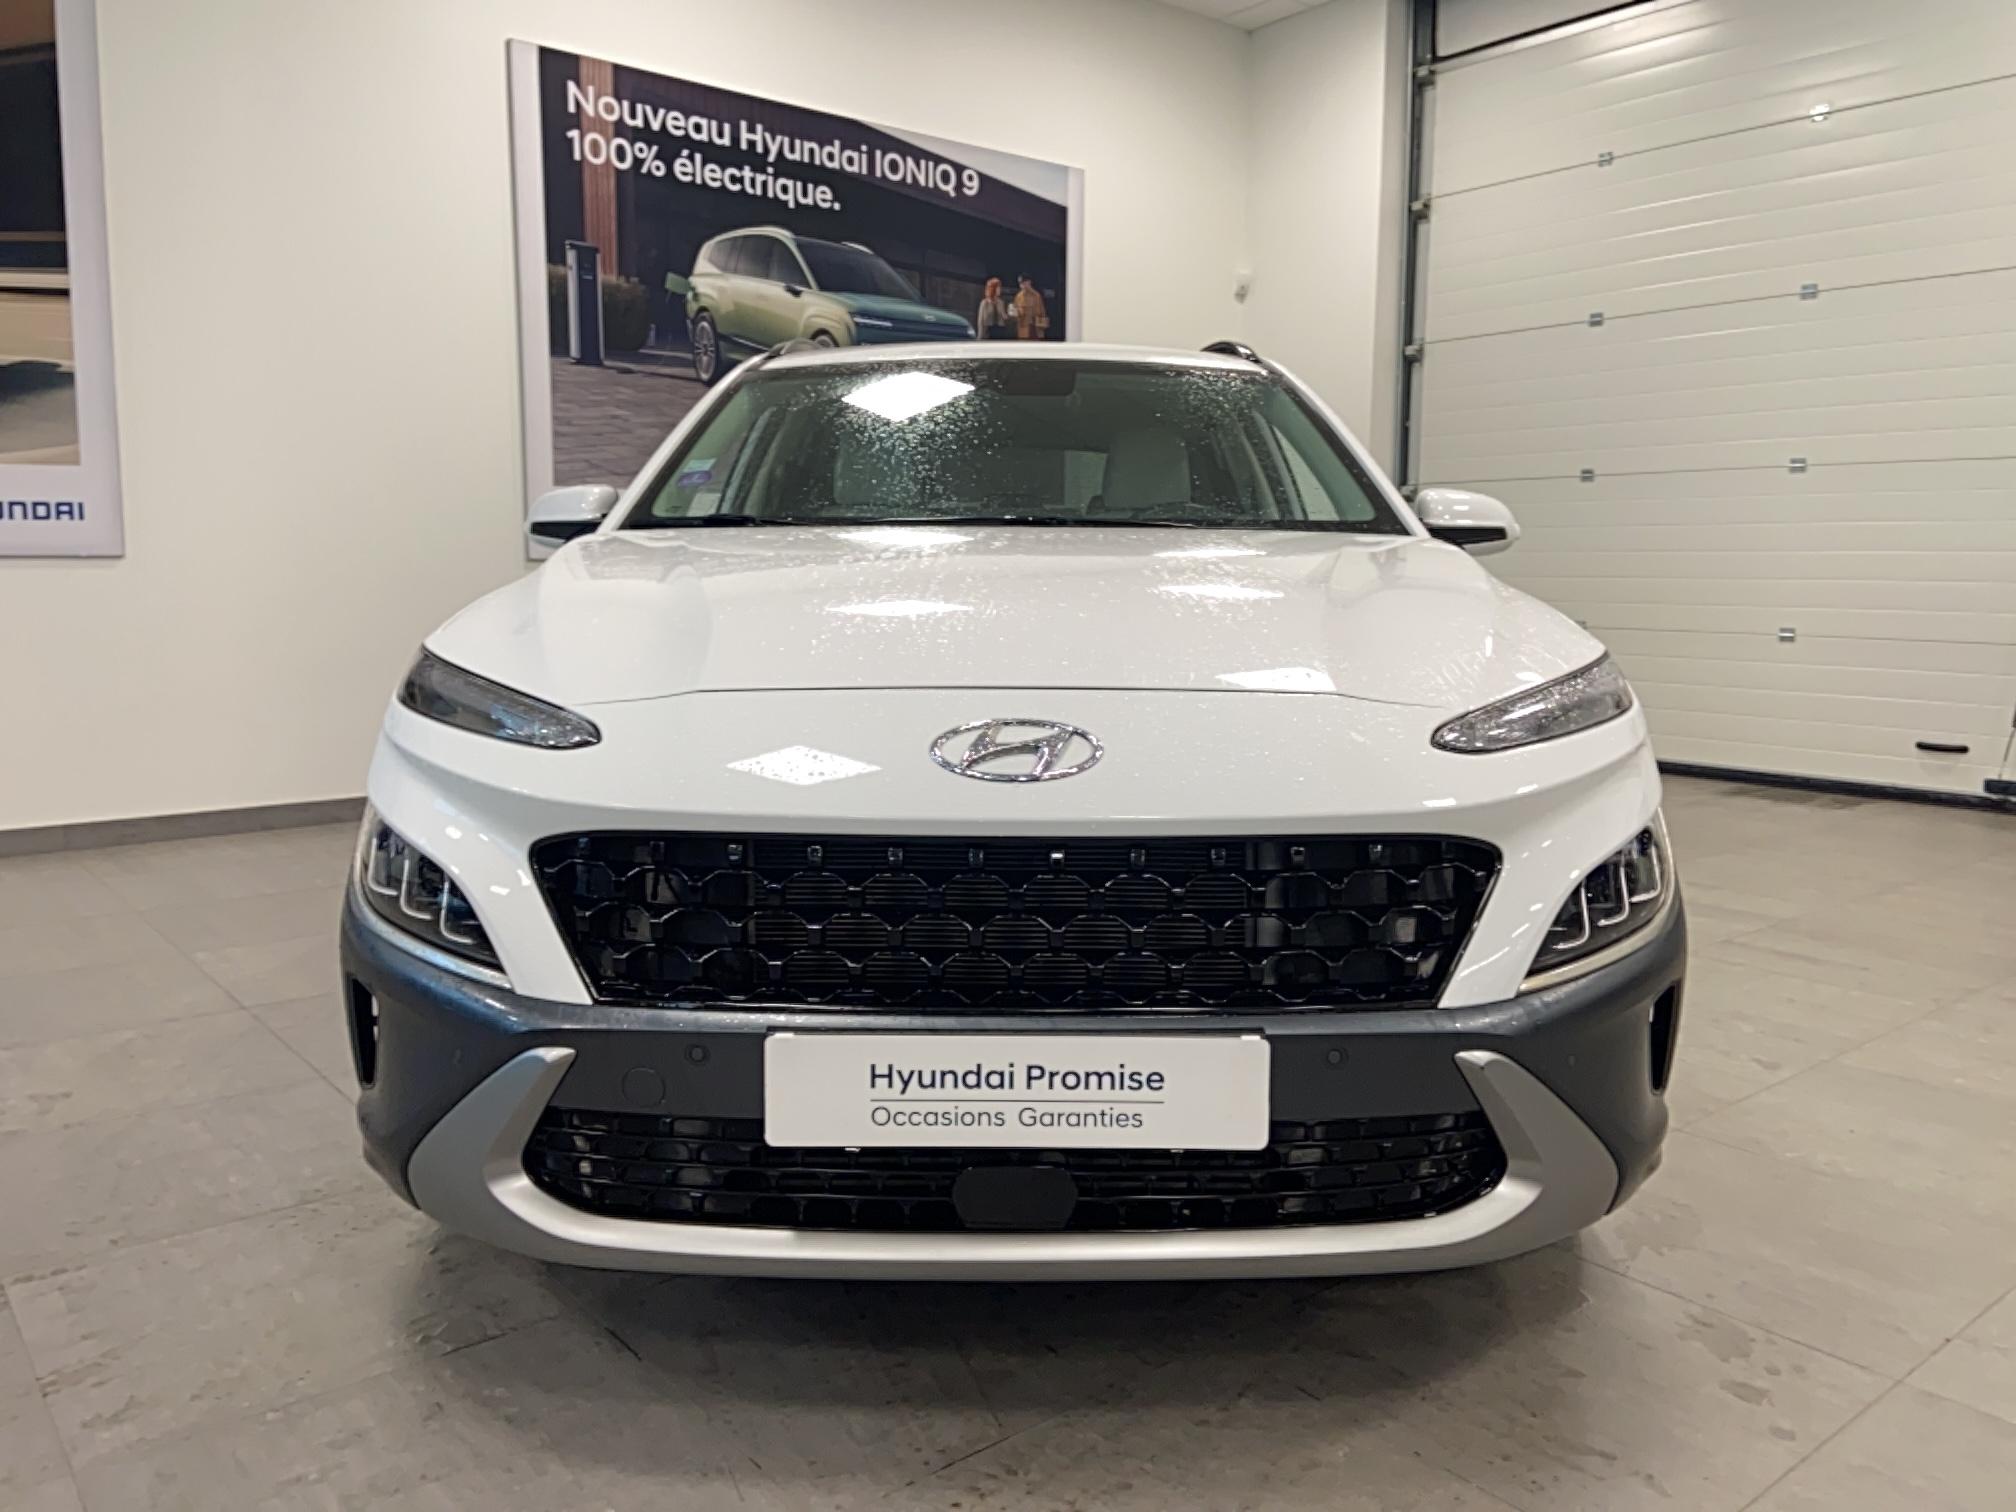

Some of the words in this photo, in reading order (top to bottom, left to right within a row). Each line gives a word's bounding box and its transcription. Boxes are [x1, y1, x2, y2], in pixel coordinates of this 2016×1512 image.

[566, 80, 731, 147] Nouveau
[739, 120, 868, 175] Hyundai
[875, 149, 956, 197] IONIQ
[962, 169, 980, 196] 9
[566, 129, 666, 177] 100%
[673, 149, 841, 210] électrique.
[0, 501, 85, 521] NDAI
[870, 1062, 1015, 1095] Hyundai
[1026, 1063, 1165, 1091] Promise
[870, 1105, 1006, 1127] Occasions
[1018, 1106, 1143, 1129] Garanties
